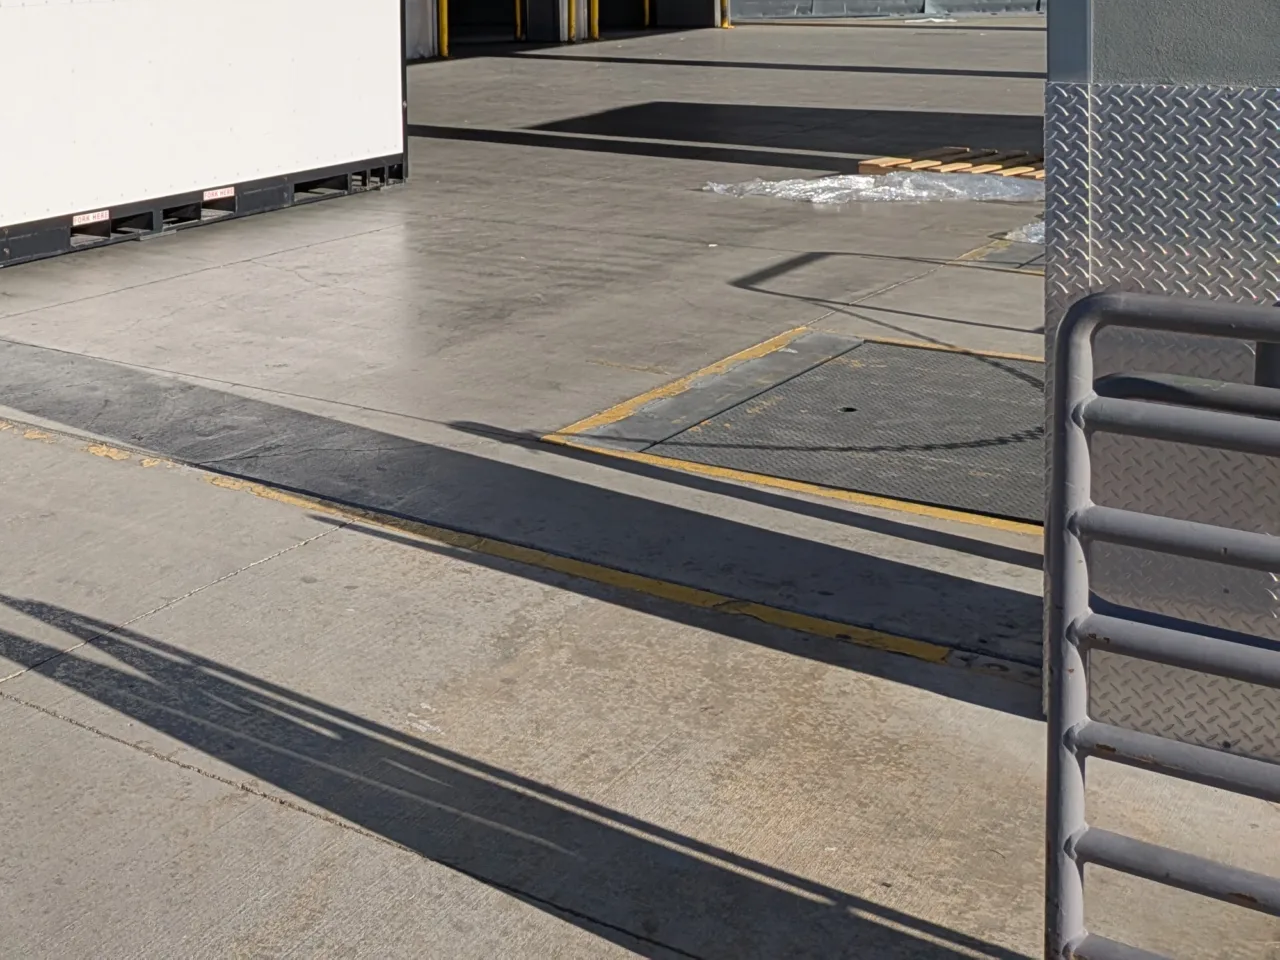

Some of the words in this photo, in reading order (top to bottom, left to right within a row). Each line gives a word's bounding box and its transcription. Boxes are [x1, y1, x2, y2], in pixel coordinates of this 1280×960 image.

[204, 190, 219, 200] FORK
[220, 186, 234, 197] HERE
[73, 214, 90, 225] FORK
[92, 210, 109, 221] HERE
